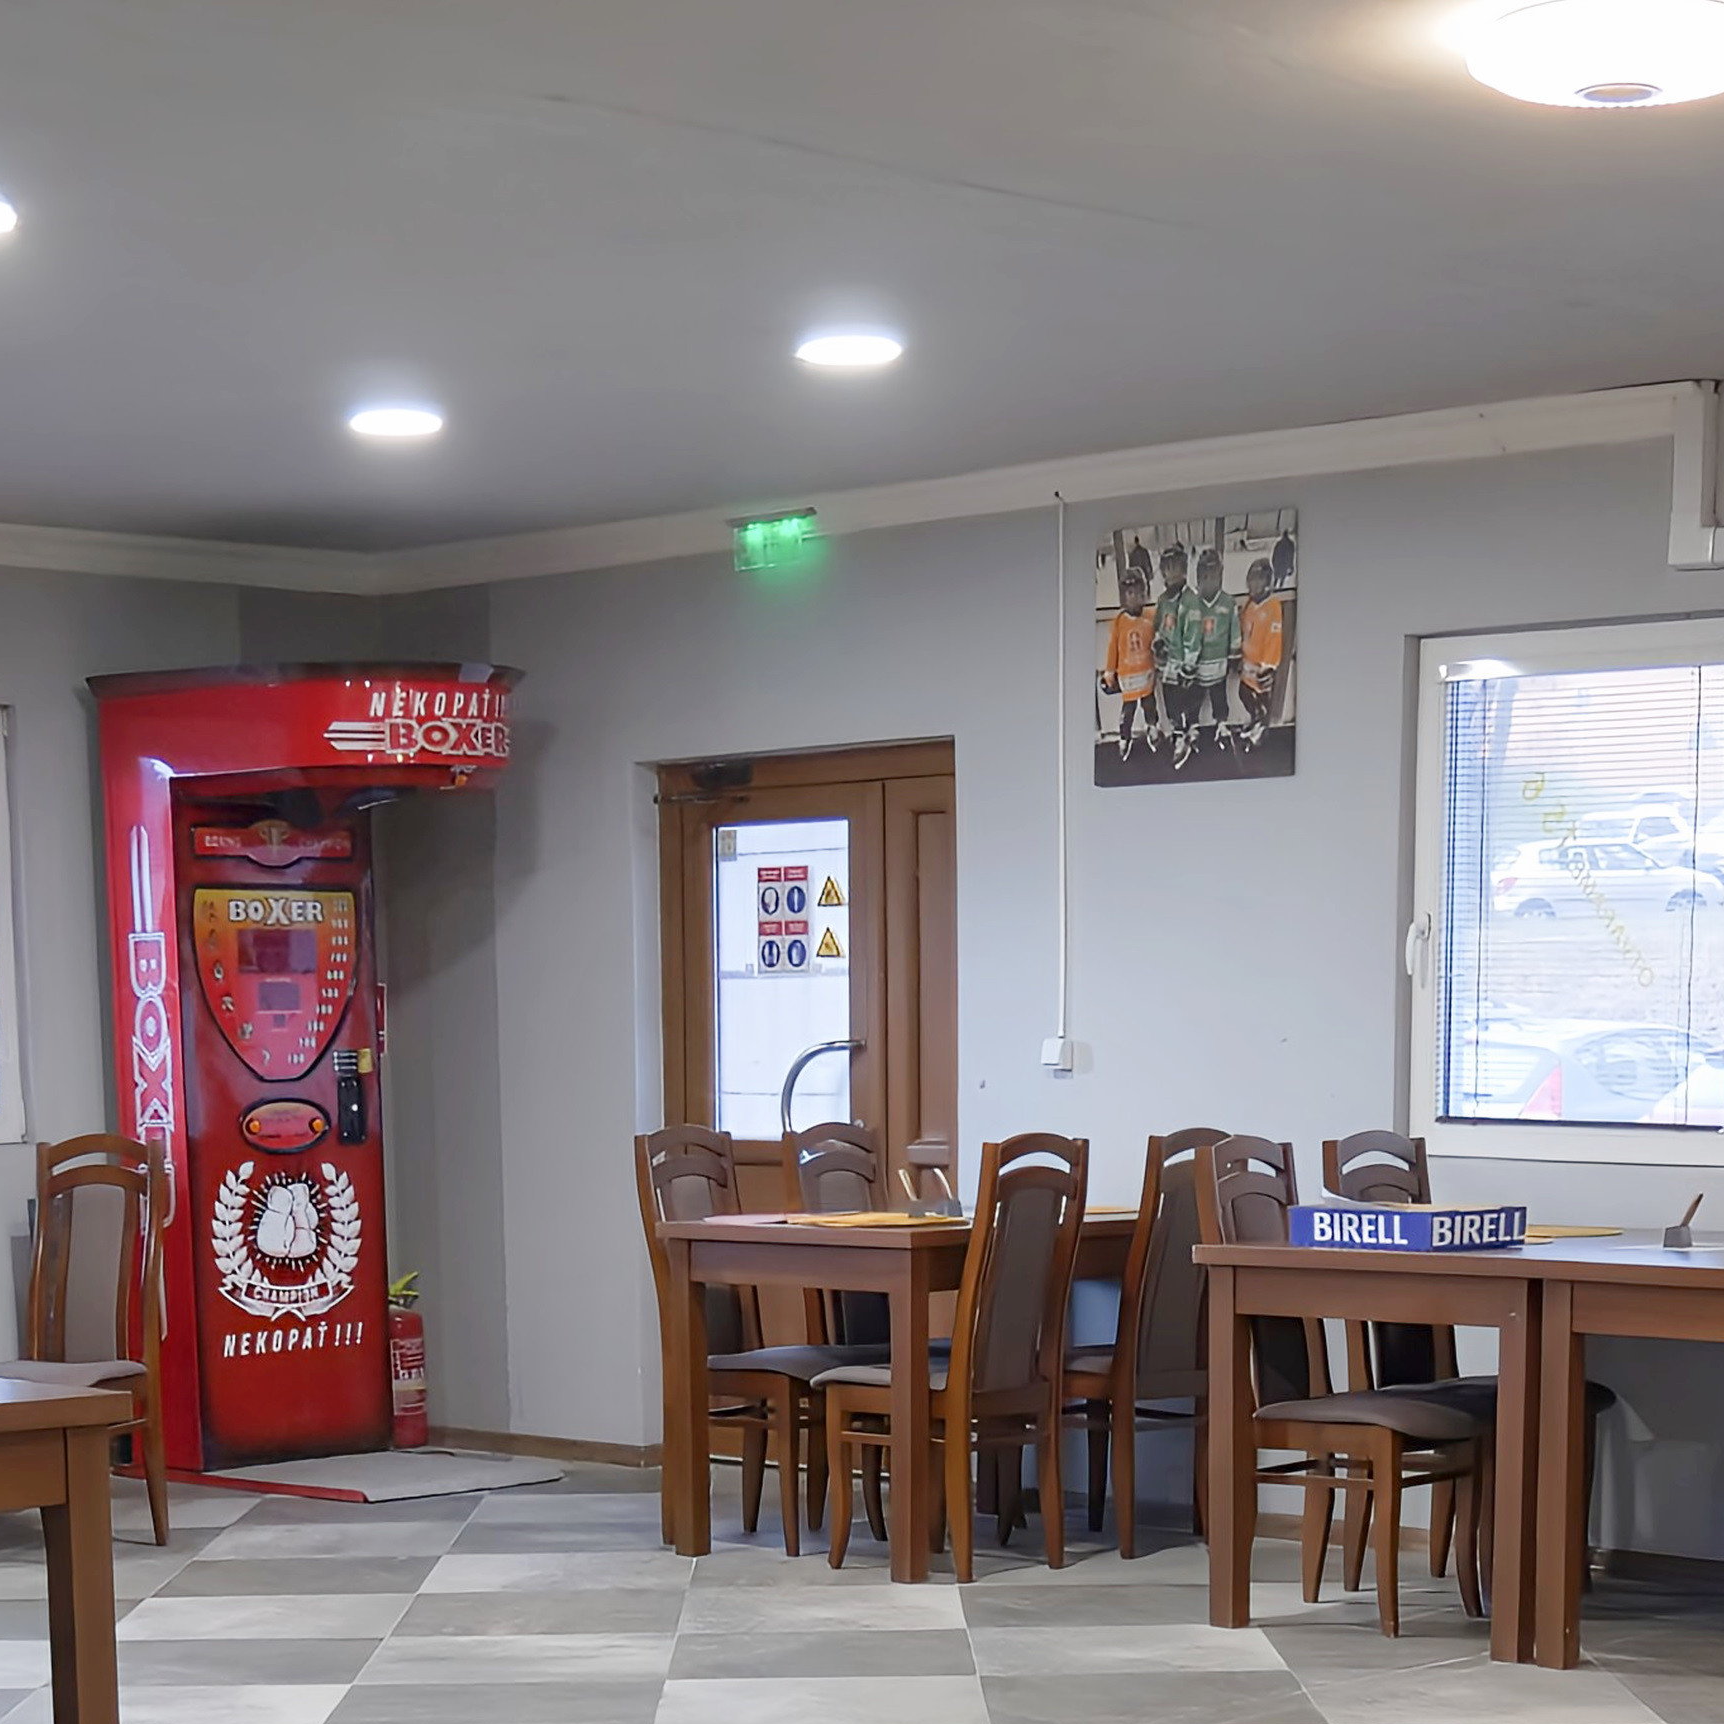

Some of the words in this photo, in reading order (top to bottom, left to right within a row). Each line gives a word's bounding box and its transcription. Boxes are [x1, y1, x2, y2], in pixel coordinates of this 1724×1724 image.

[228, 898, 323, 926] BOXER
[1313, 1212, 1408, 1245] BIRELL
[1432, 1211, 1526, 1247] BIRELL
